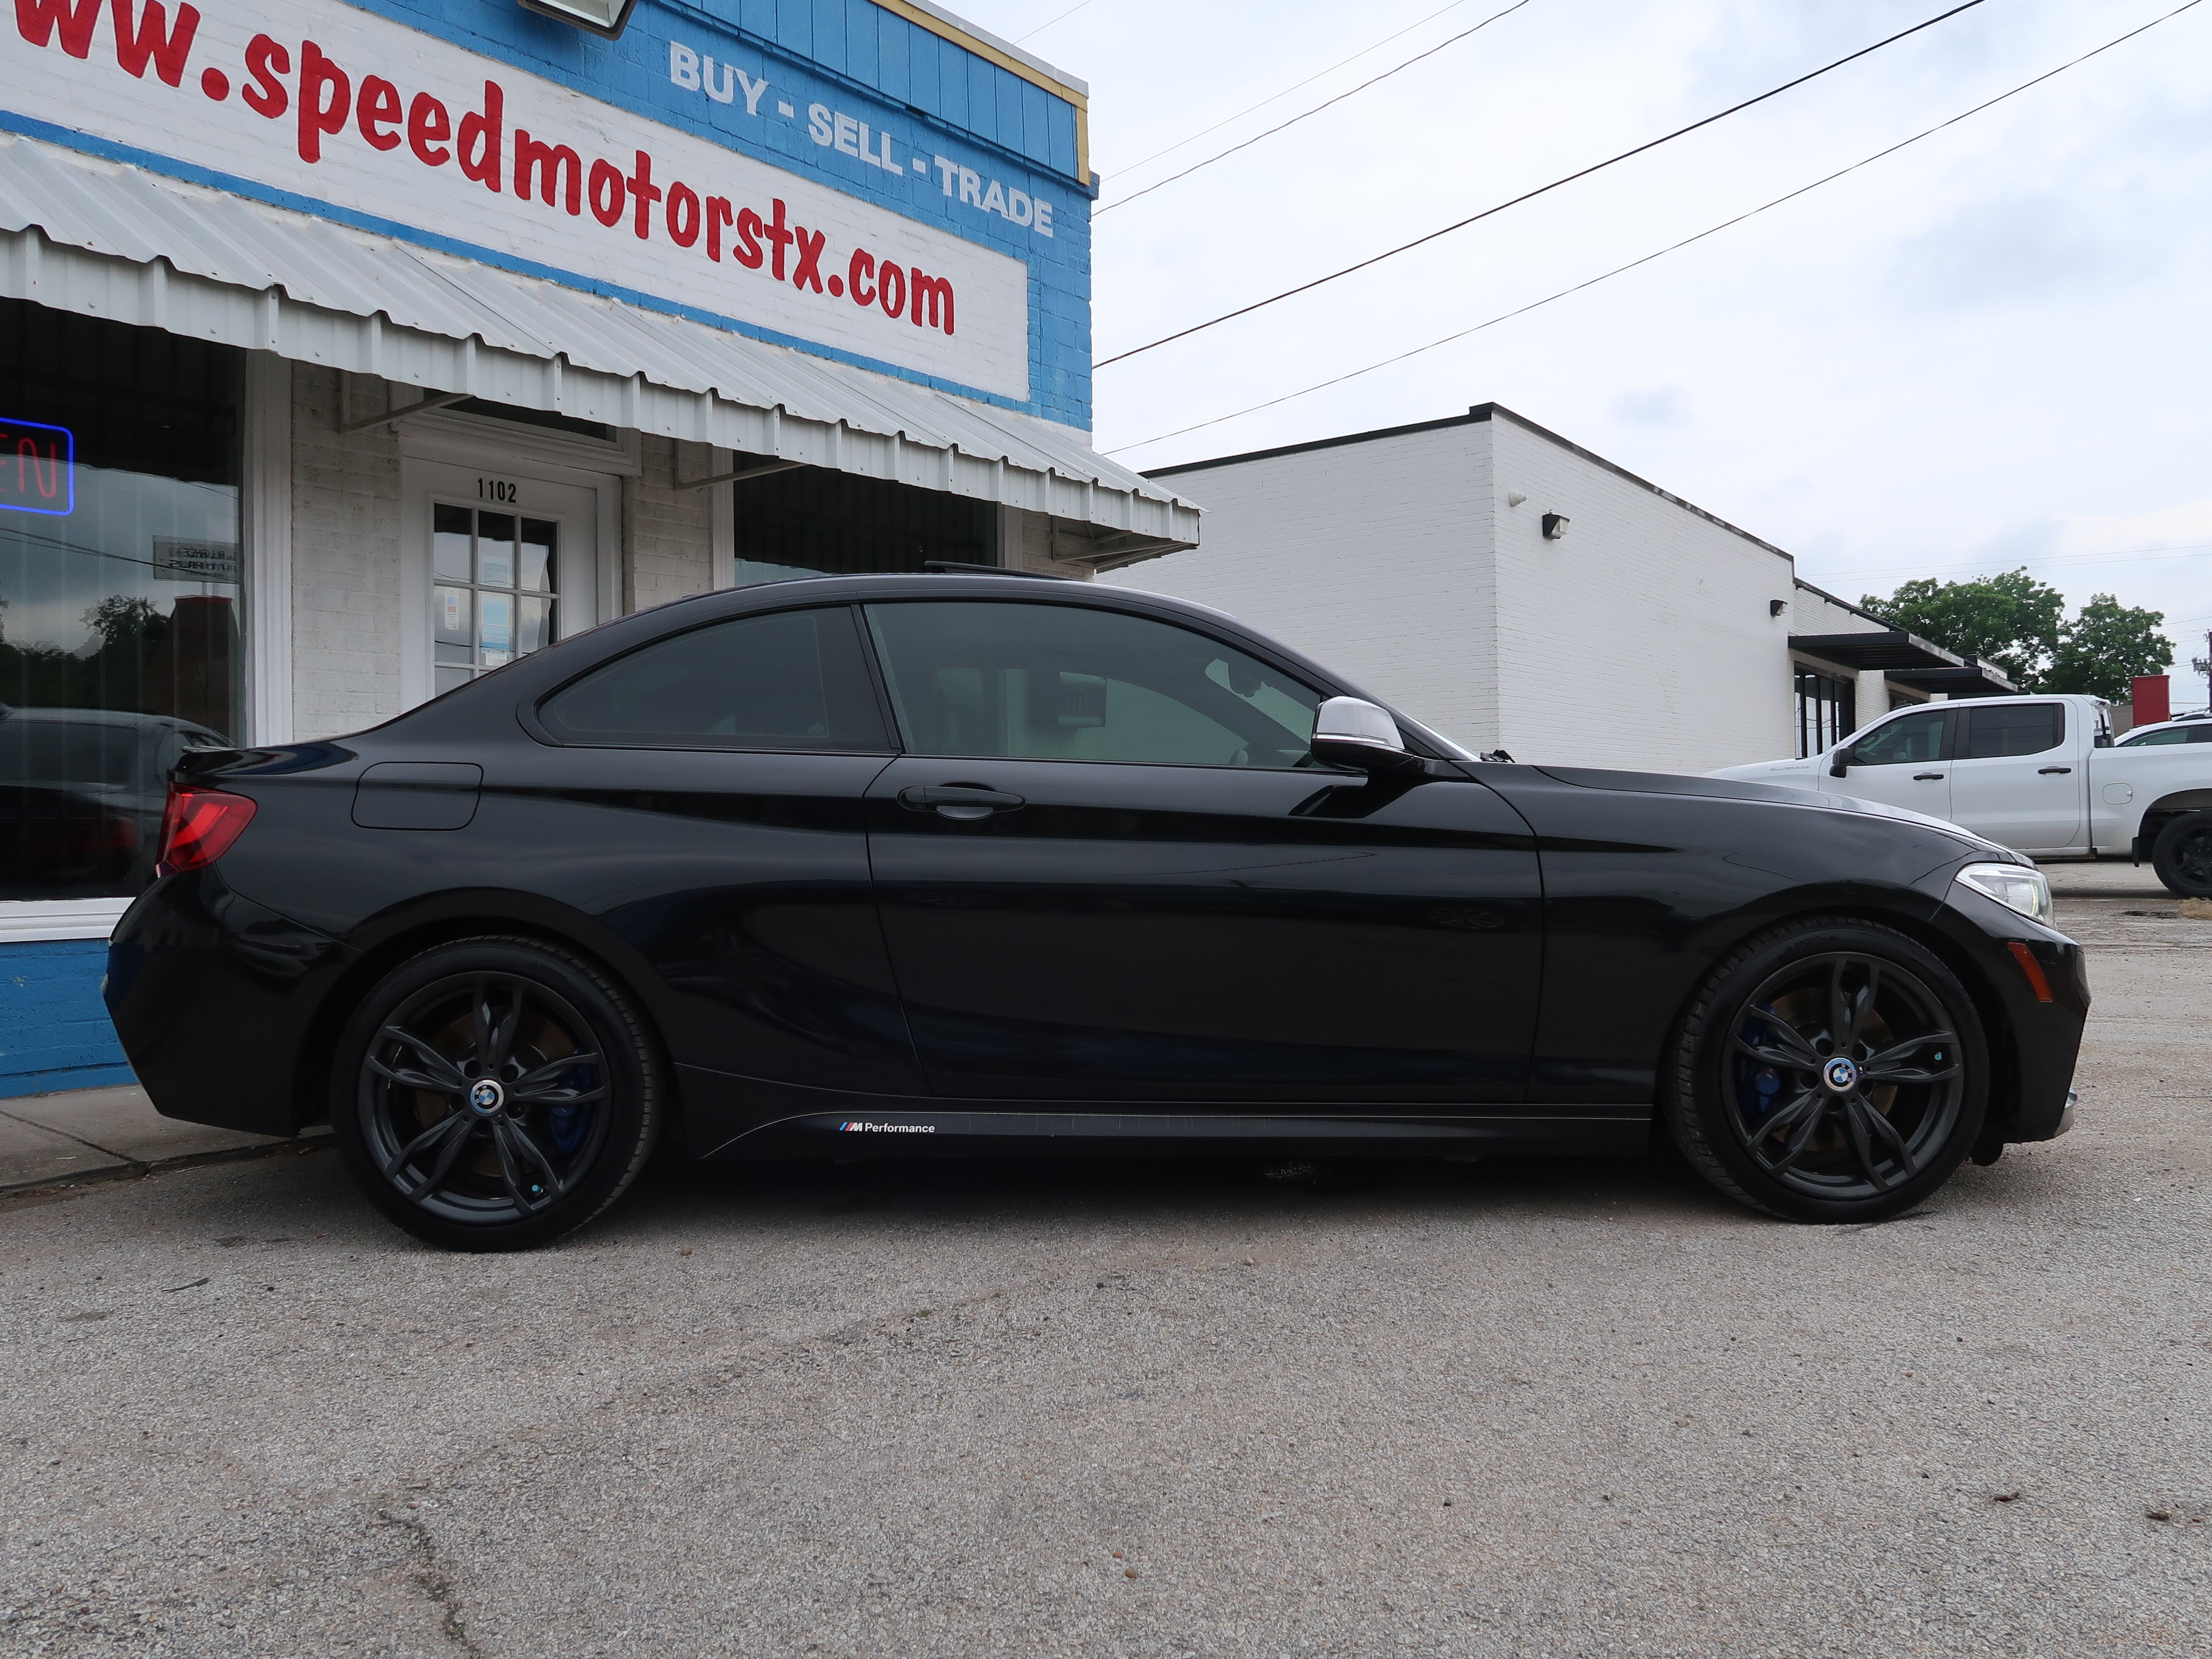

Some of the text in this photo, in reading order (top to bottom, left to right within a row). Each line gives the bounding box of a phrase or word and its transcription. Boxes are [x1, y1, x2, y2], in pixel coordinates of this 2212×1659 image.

[670, 40, 769, 116] BUY
[808, 103, 904, 176] SELL
[934, 155, 1054, 238] TRADE
[478, 478, 516, 503] 1102
[865, 1122, 935, 1133] Performance
